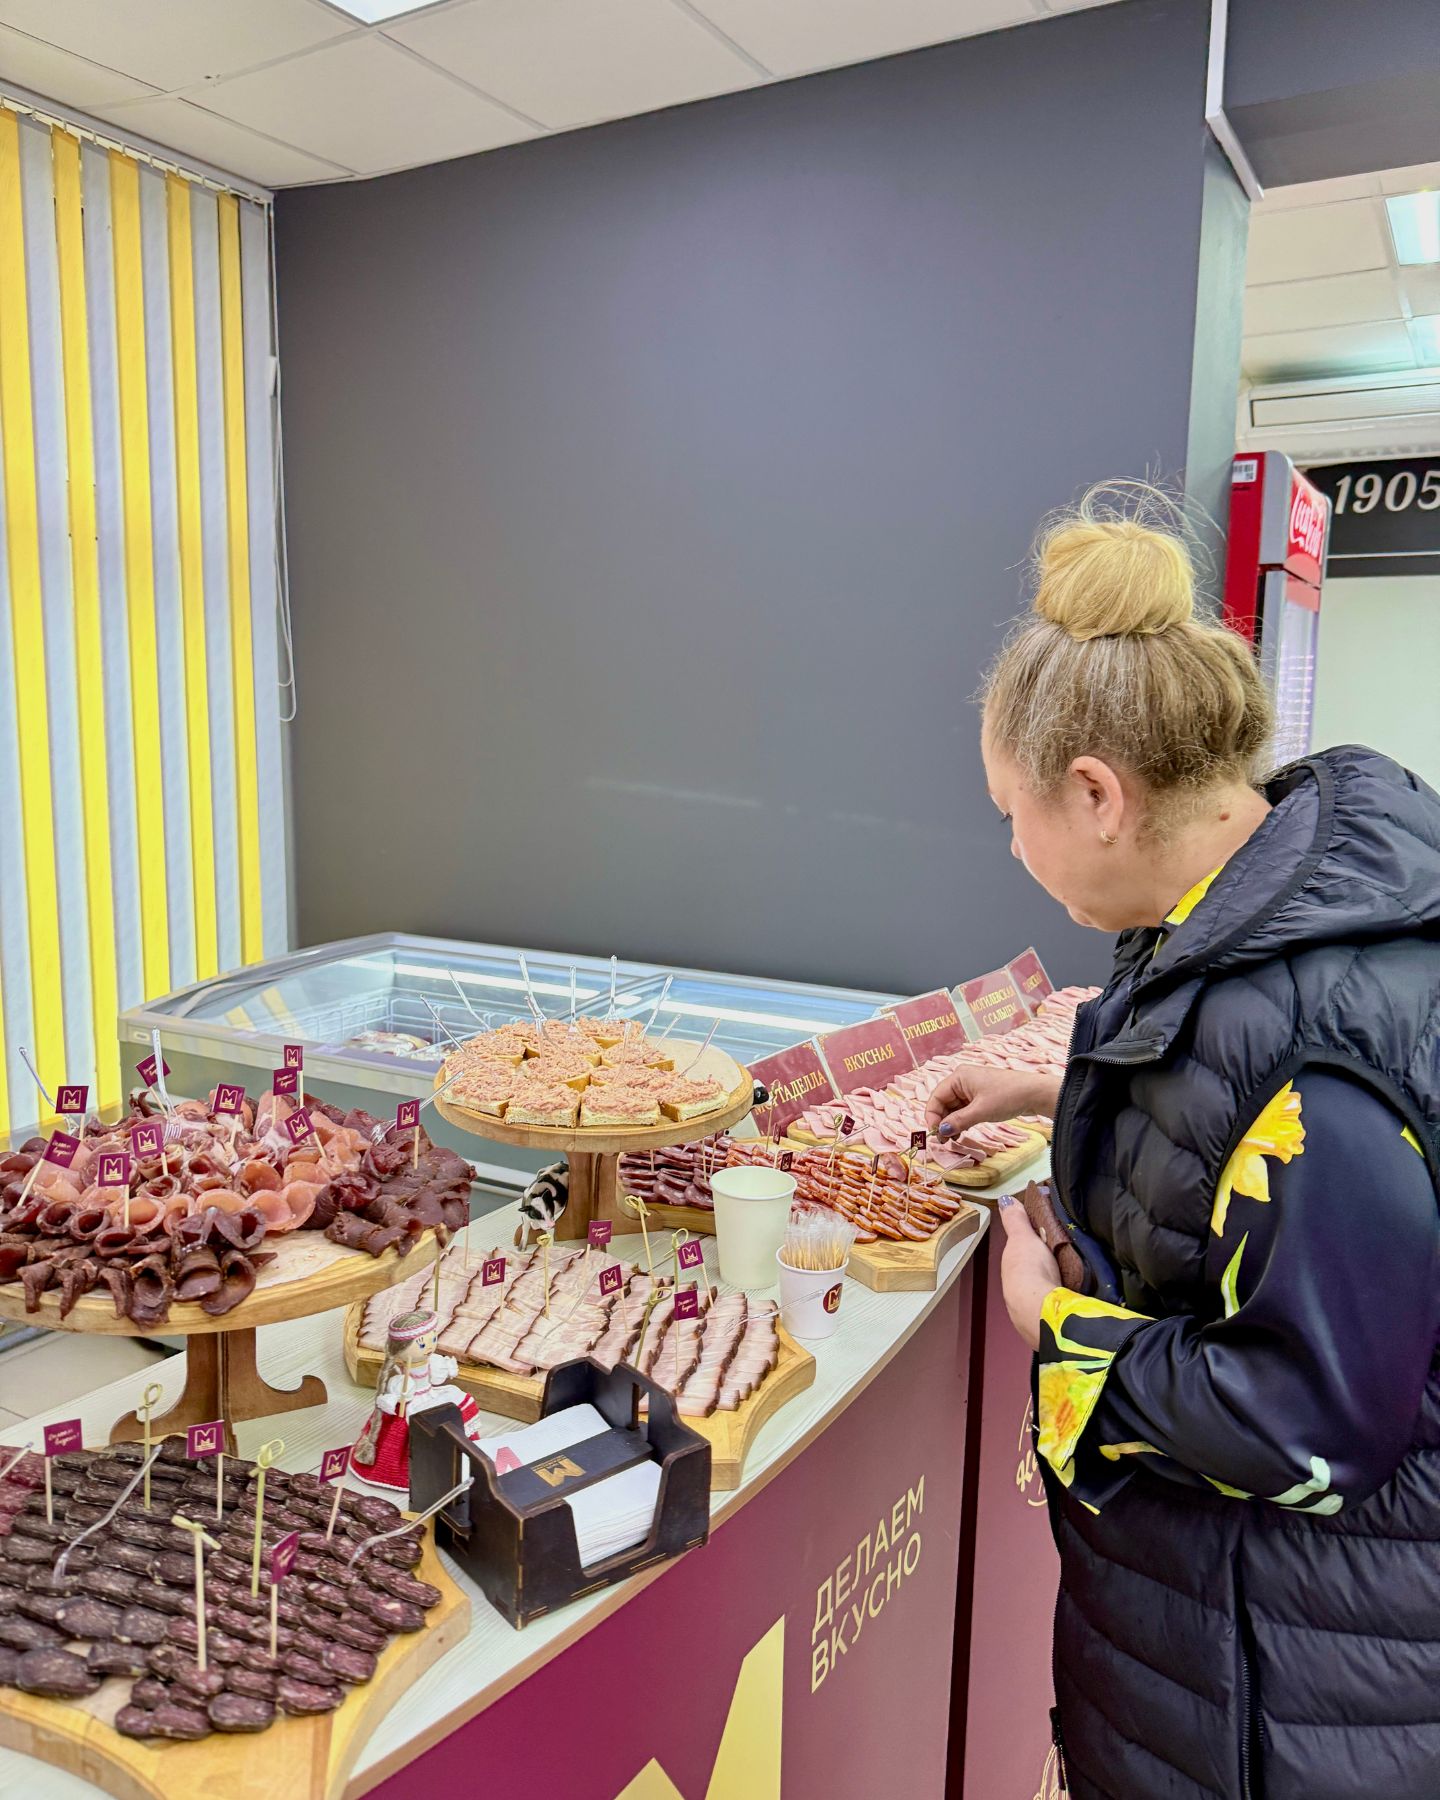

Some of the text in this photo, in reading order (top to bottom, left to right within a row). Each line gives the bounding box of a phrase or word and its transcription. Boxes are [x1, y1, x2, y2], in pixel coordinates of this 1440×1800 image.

[1335, 470, 1440, 514] 1905
[969, 985, 1016, 1014] МОГИЛЕВСКАЯ
[902, 1012, 958, 1041] ОГИЛЕВСКАЯ
[982, 1015, 991, 1027] С
[843, 1043, 895, 1073] ВКУСНАЯ
[812, 1474, 925, 1645] ДЕЛАЕМ
[811, 1532, 922, 1694] ВКУСНО
